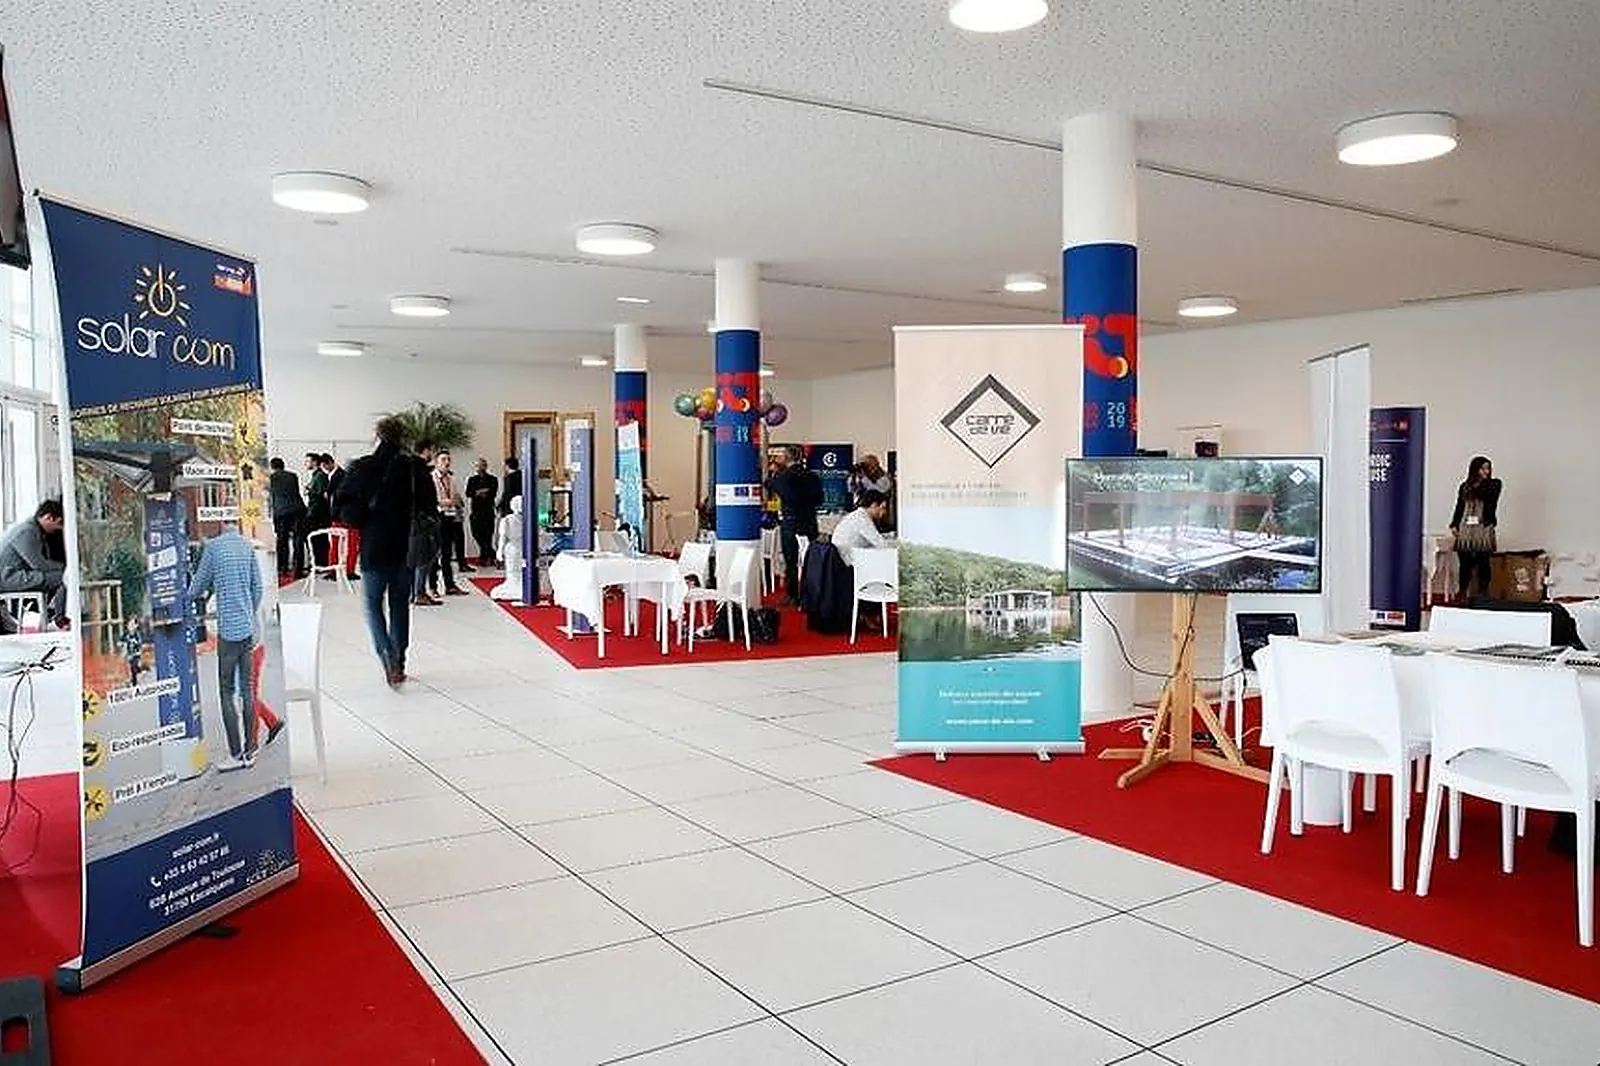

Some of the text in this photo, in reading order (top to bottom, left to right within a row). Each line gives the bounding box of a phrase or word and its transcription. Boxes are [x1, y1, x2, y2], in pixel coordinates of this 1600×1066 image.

[77, 313, 235, 370] solar com
[1107, 402, 1126, 415] 20
[1107, 415, 1126, 429] 19
